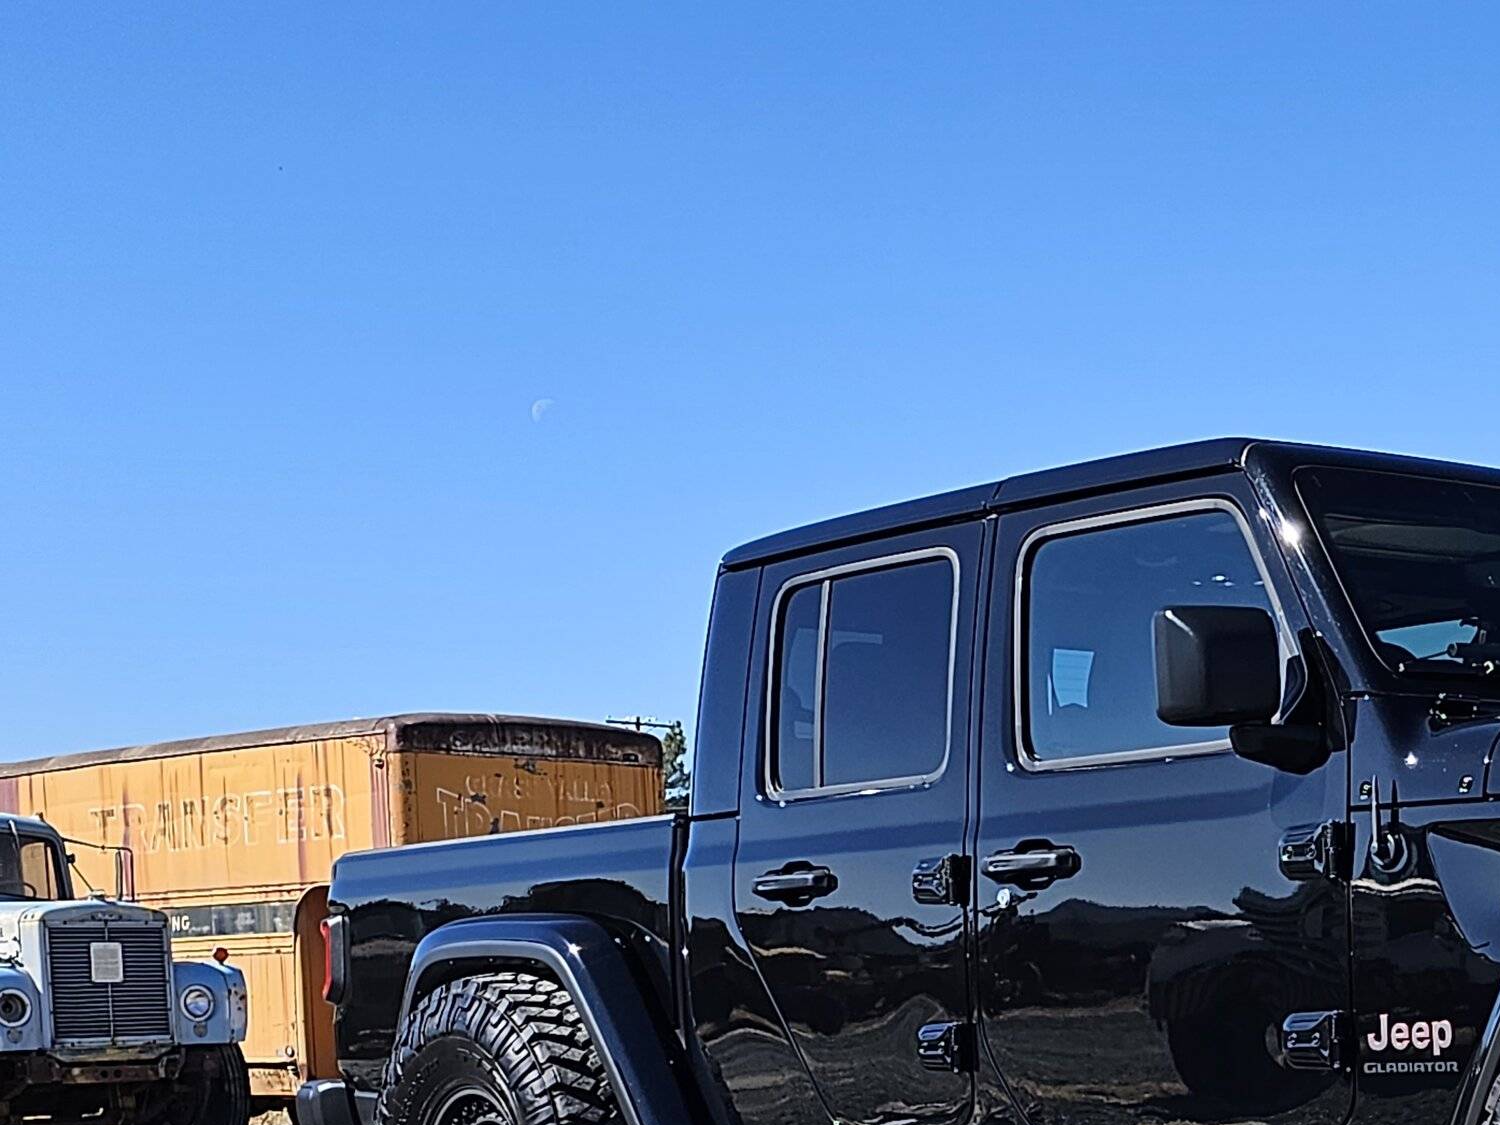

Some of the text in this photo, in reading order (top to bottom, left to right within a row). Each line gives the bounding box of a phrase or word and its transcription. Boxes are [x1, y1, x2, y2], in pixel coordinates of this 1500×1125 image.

[88, 783, 346, 852] TRANSFER
[1367, 1013, 1452, 1056] Jeep
[1363, 1061, 1459, 1074] GLADIATOR
